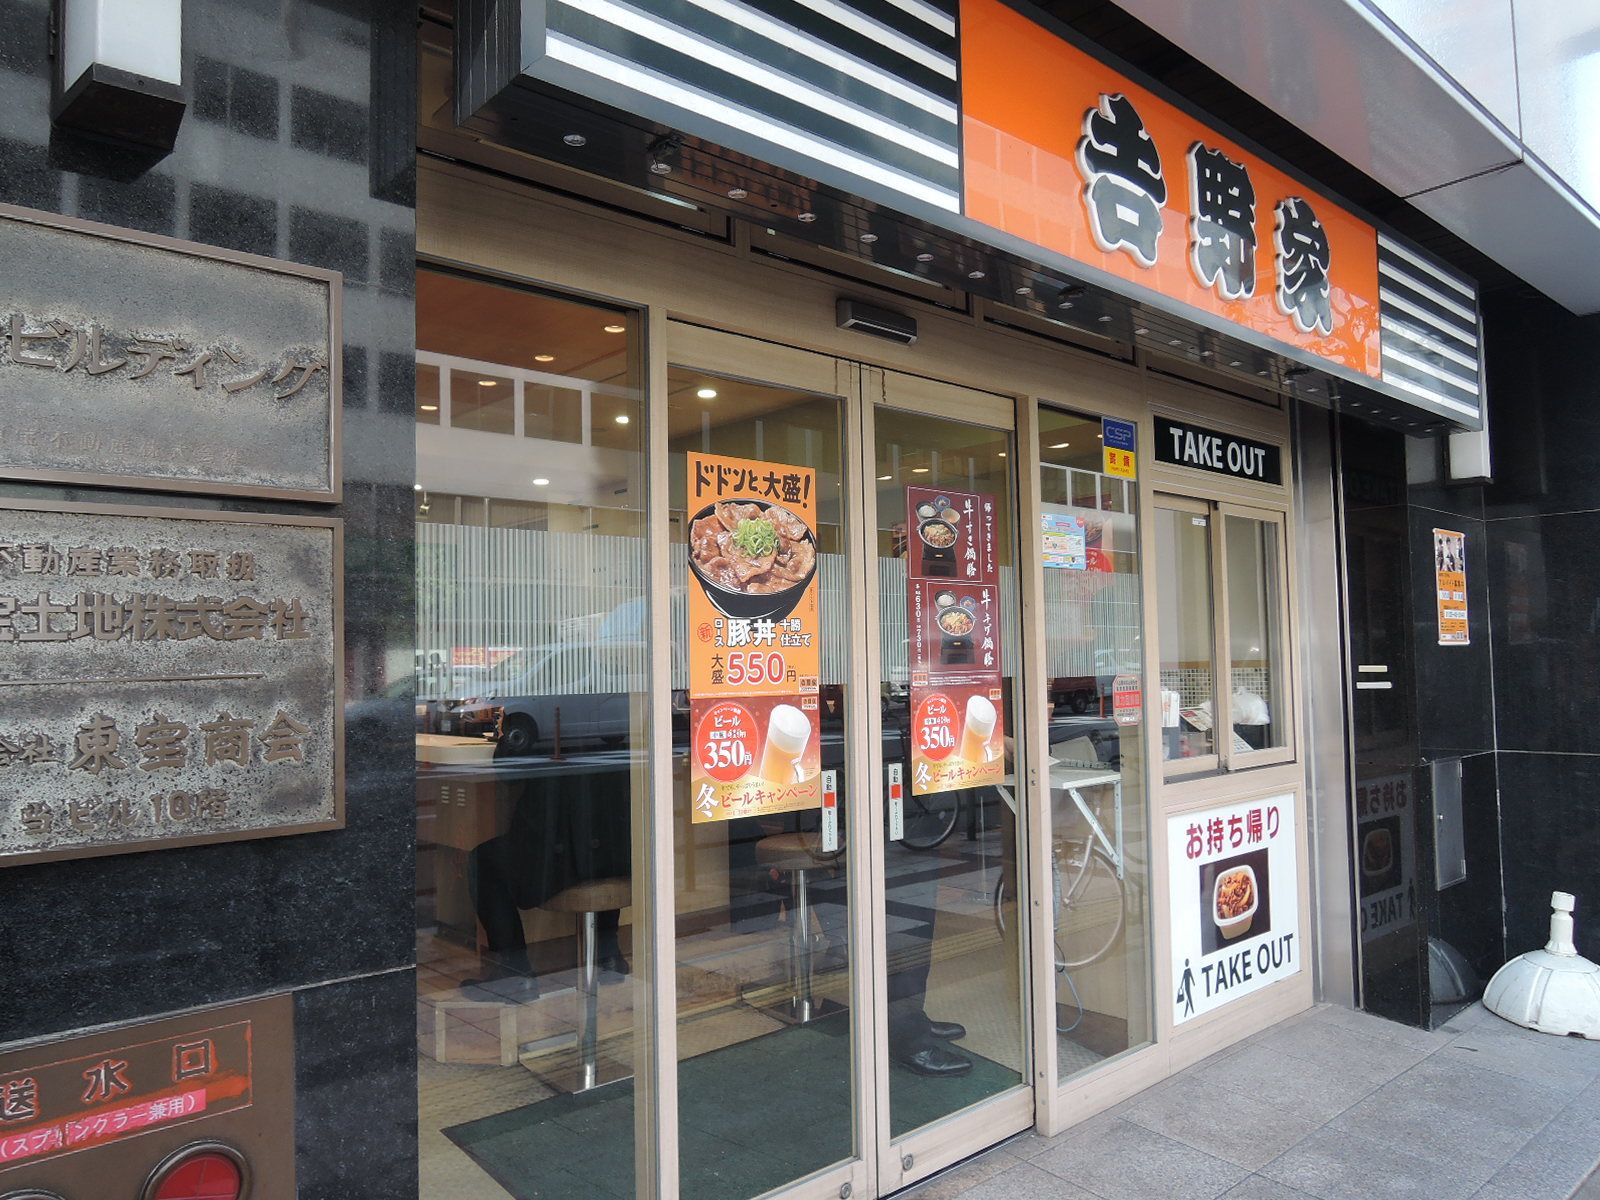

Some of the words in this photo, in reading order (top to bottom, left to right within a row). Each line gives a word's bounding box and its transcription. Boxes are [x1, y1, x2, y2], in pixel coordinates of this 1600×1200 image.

[7, 312, 328, 400] ビルディング
[1170, 427, 1223, 469] TAKE
[1227, 442, 1266, 478] OUT
[727, 618, 776, 647] 豚丼
[714, 715, 742, 728] ビール
[721, 785, 817, 809] ビールキャンペーン
[915, 761, 932, 791] 冬
[695, 783, 720, 818] 冬
[1185, 805, 1280, 860] お持ち帰り
[1202, 949, 1252, 997] TAKE
[1257, 933, 1294, 973] OUT
[0, 1039, 212, 1121] 送水口
